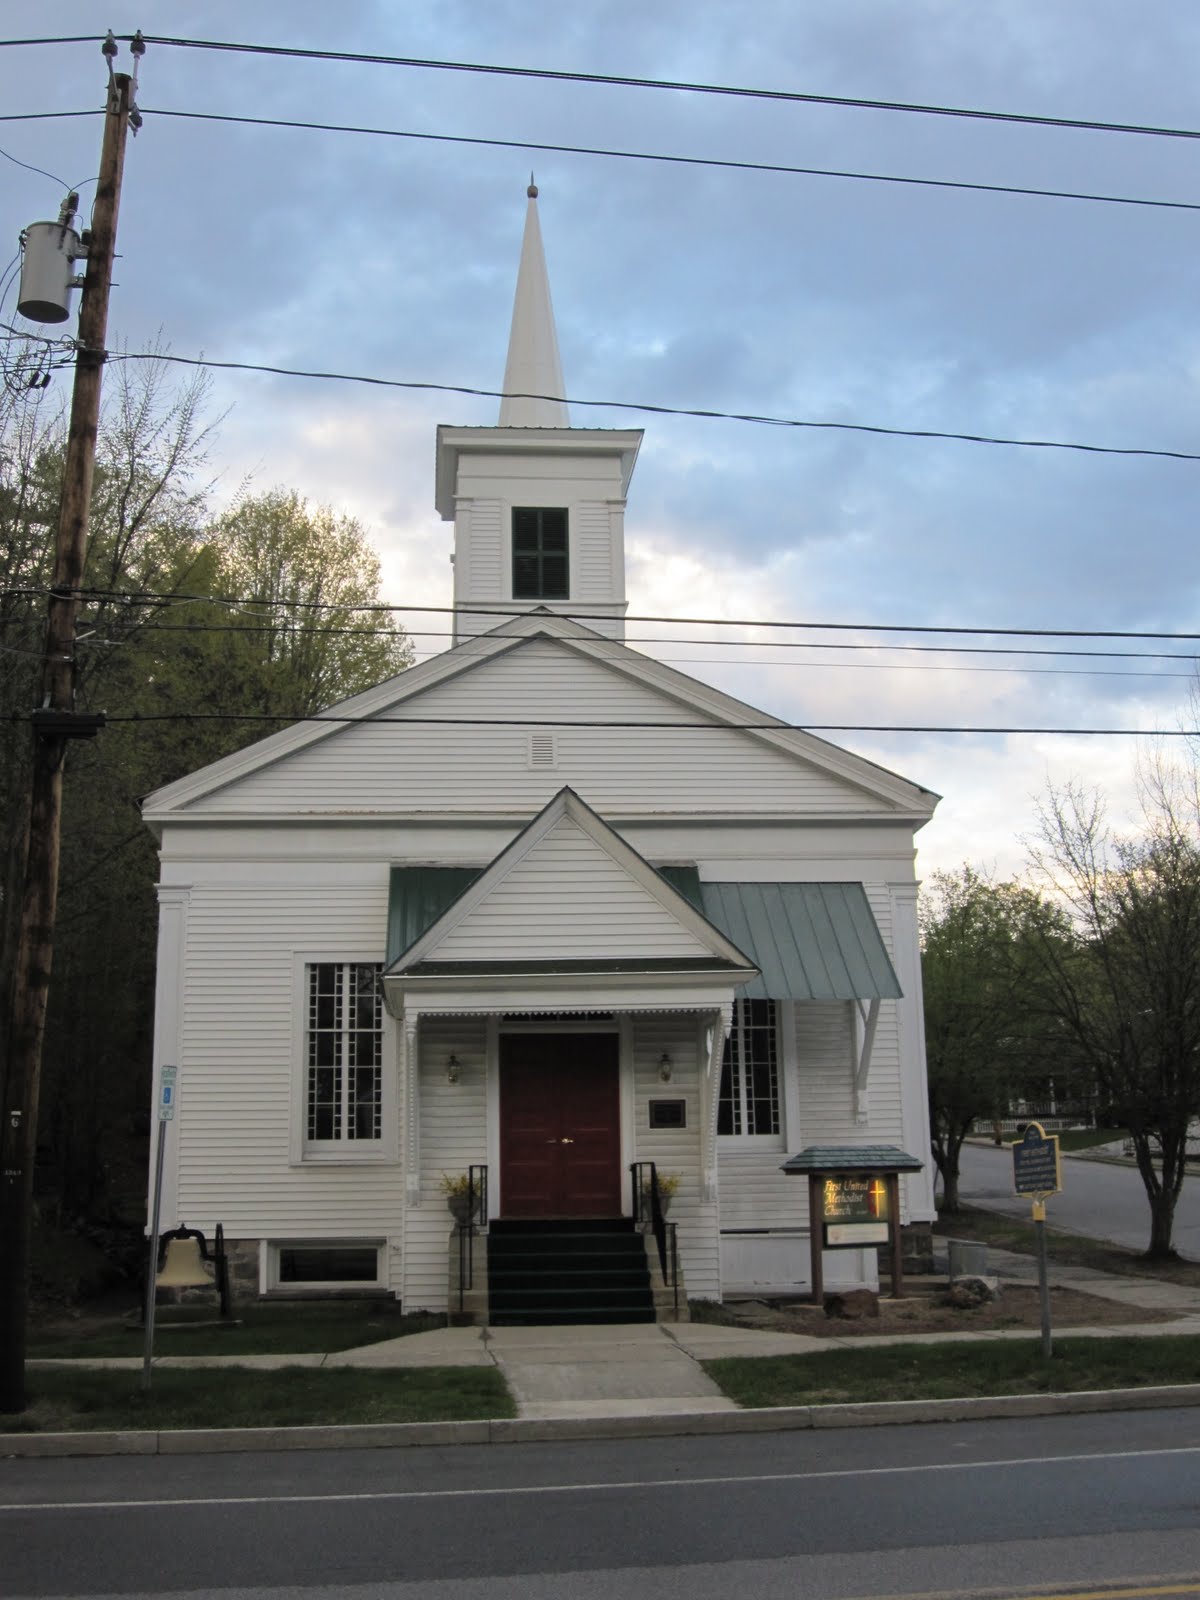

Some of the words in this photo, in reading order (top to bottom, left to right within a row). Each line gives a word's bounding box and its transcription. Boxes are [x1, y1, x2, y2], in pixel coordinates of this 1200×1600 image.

[11, 1117, 19, 1128] 6
[824, 1180, 842, 1193] First
[844, 1179, 869, 1191] United
[825, 1192, 864, 1204] Methodist
[824, 1204, 852, 1216] Church
